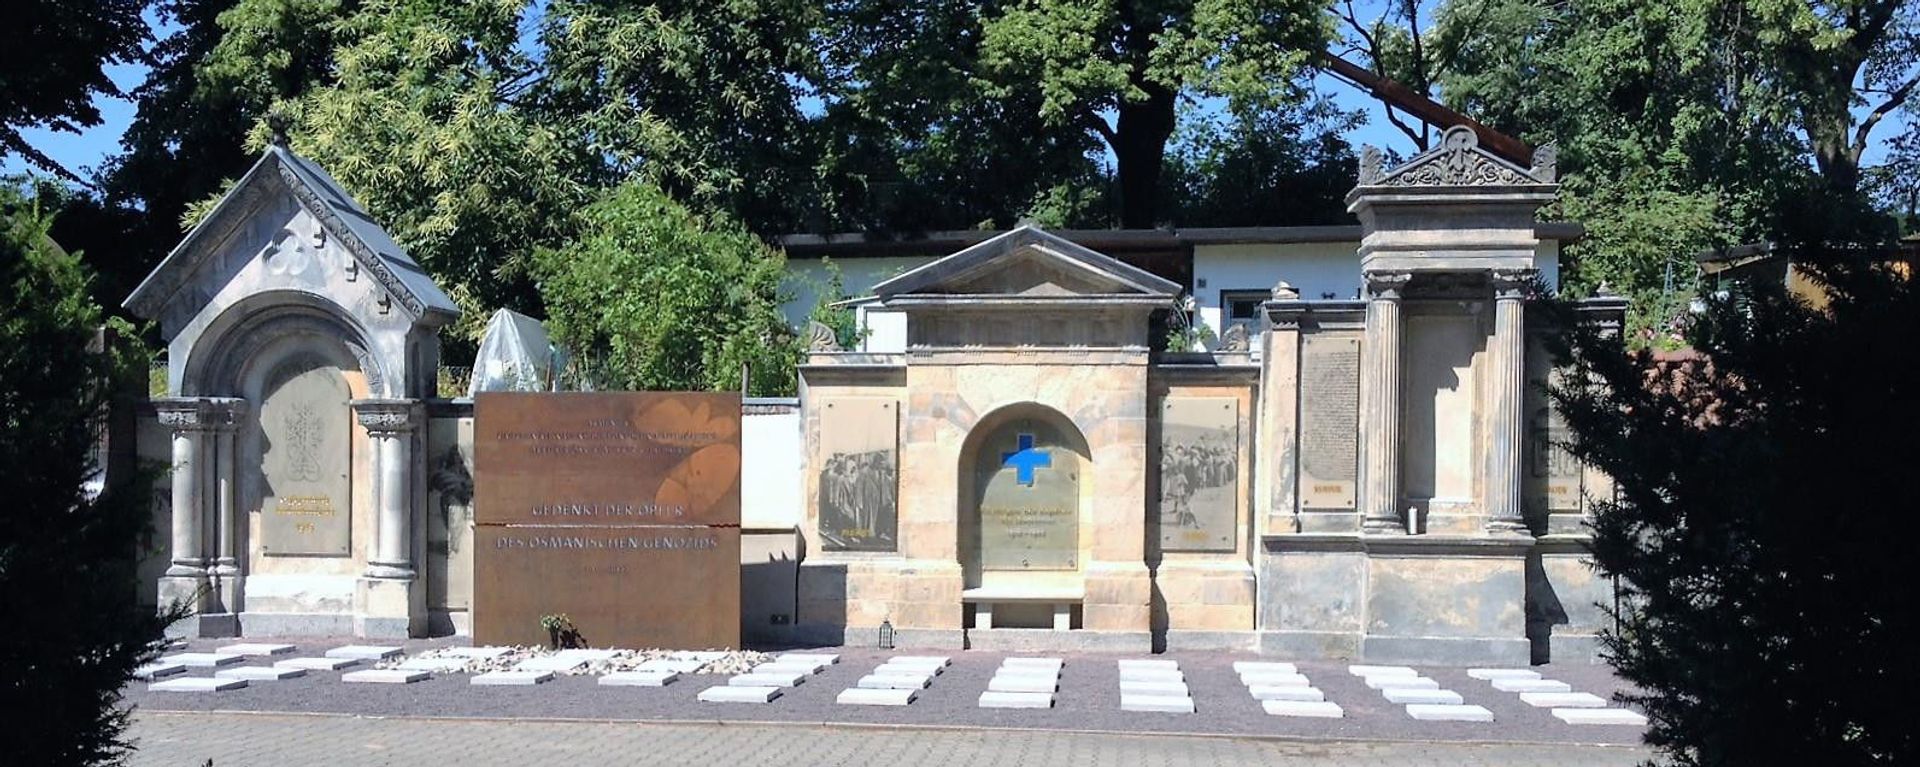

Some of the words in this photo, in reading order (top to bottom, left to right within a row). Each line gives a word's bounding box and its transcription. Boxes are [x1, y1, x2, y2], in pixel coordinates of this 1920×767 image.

[532, 504, 599, 516] GEDENKT
[606, 504, 633, 516] DER
[496, 537, 524, 549] DES
[529, 537, 638, 549] OSMANISCHEN
[643, 537, 718, 549] GENOZIDS
